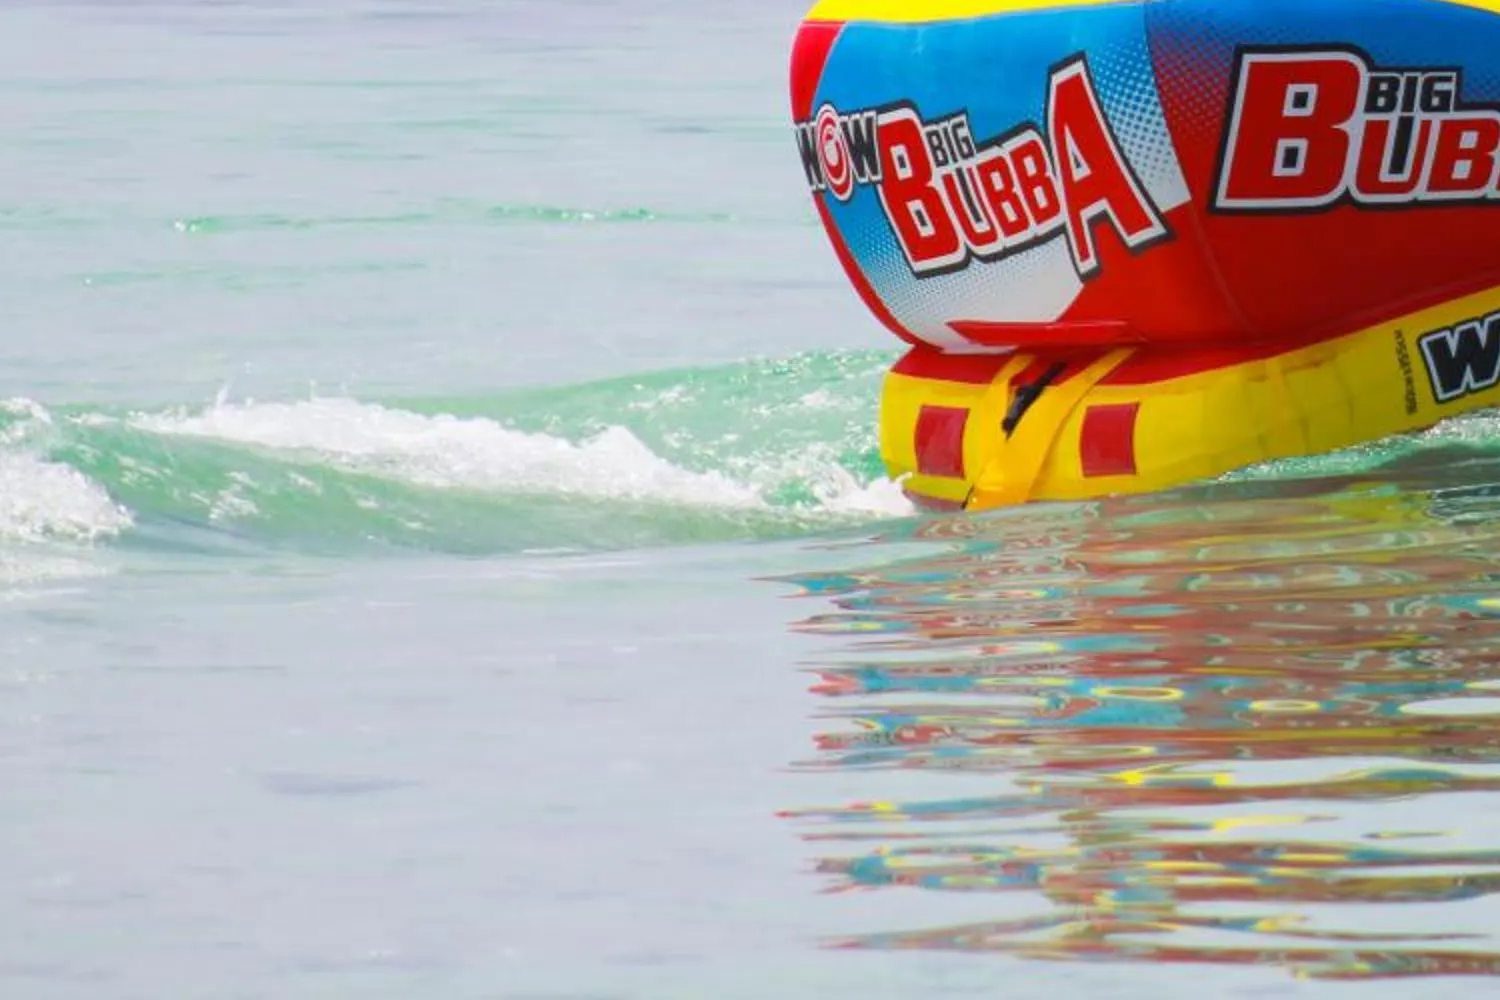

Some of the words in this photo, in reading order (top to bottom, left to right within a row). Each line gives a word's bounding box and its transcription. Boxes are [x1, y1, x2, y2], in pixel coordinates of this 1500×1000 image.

[1362, 70, 1458, 115] BIG
[796, 103, 883, 201] WOW
[876, 54, 1174, 281] BUBBA
[926, 114, 976, 166] BIG
